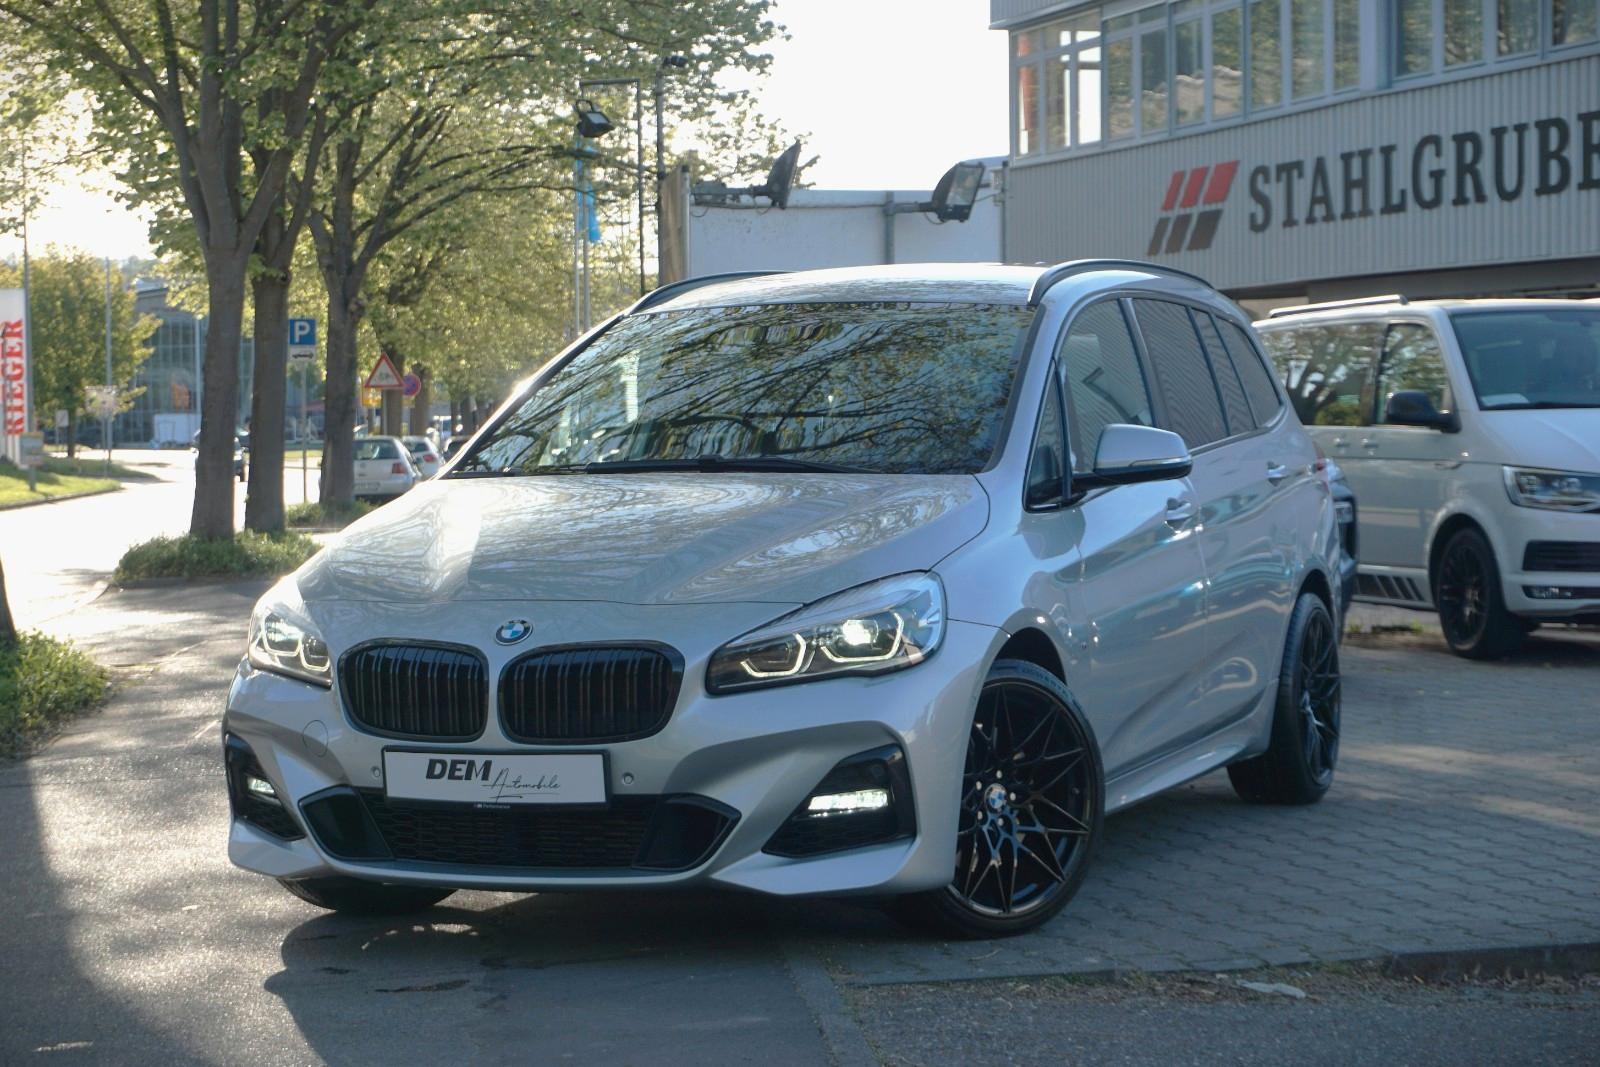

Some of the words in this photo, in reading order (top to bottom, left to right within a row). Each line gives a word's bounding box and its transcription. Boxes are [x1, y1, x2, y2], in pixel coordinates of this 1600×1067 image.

[1249, 111, 1600, 233] STAHLGRUBE
[294, 321, 310, 343] P
[1, 319, 25, 436] RIEGER
[426, 759, 492, 781] DEM
